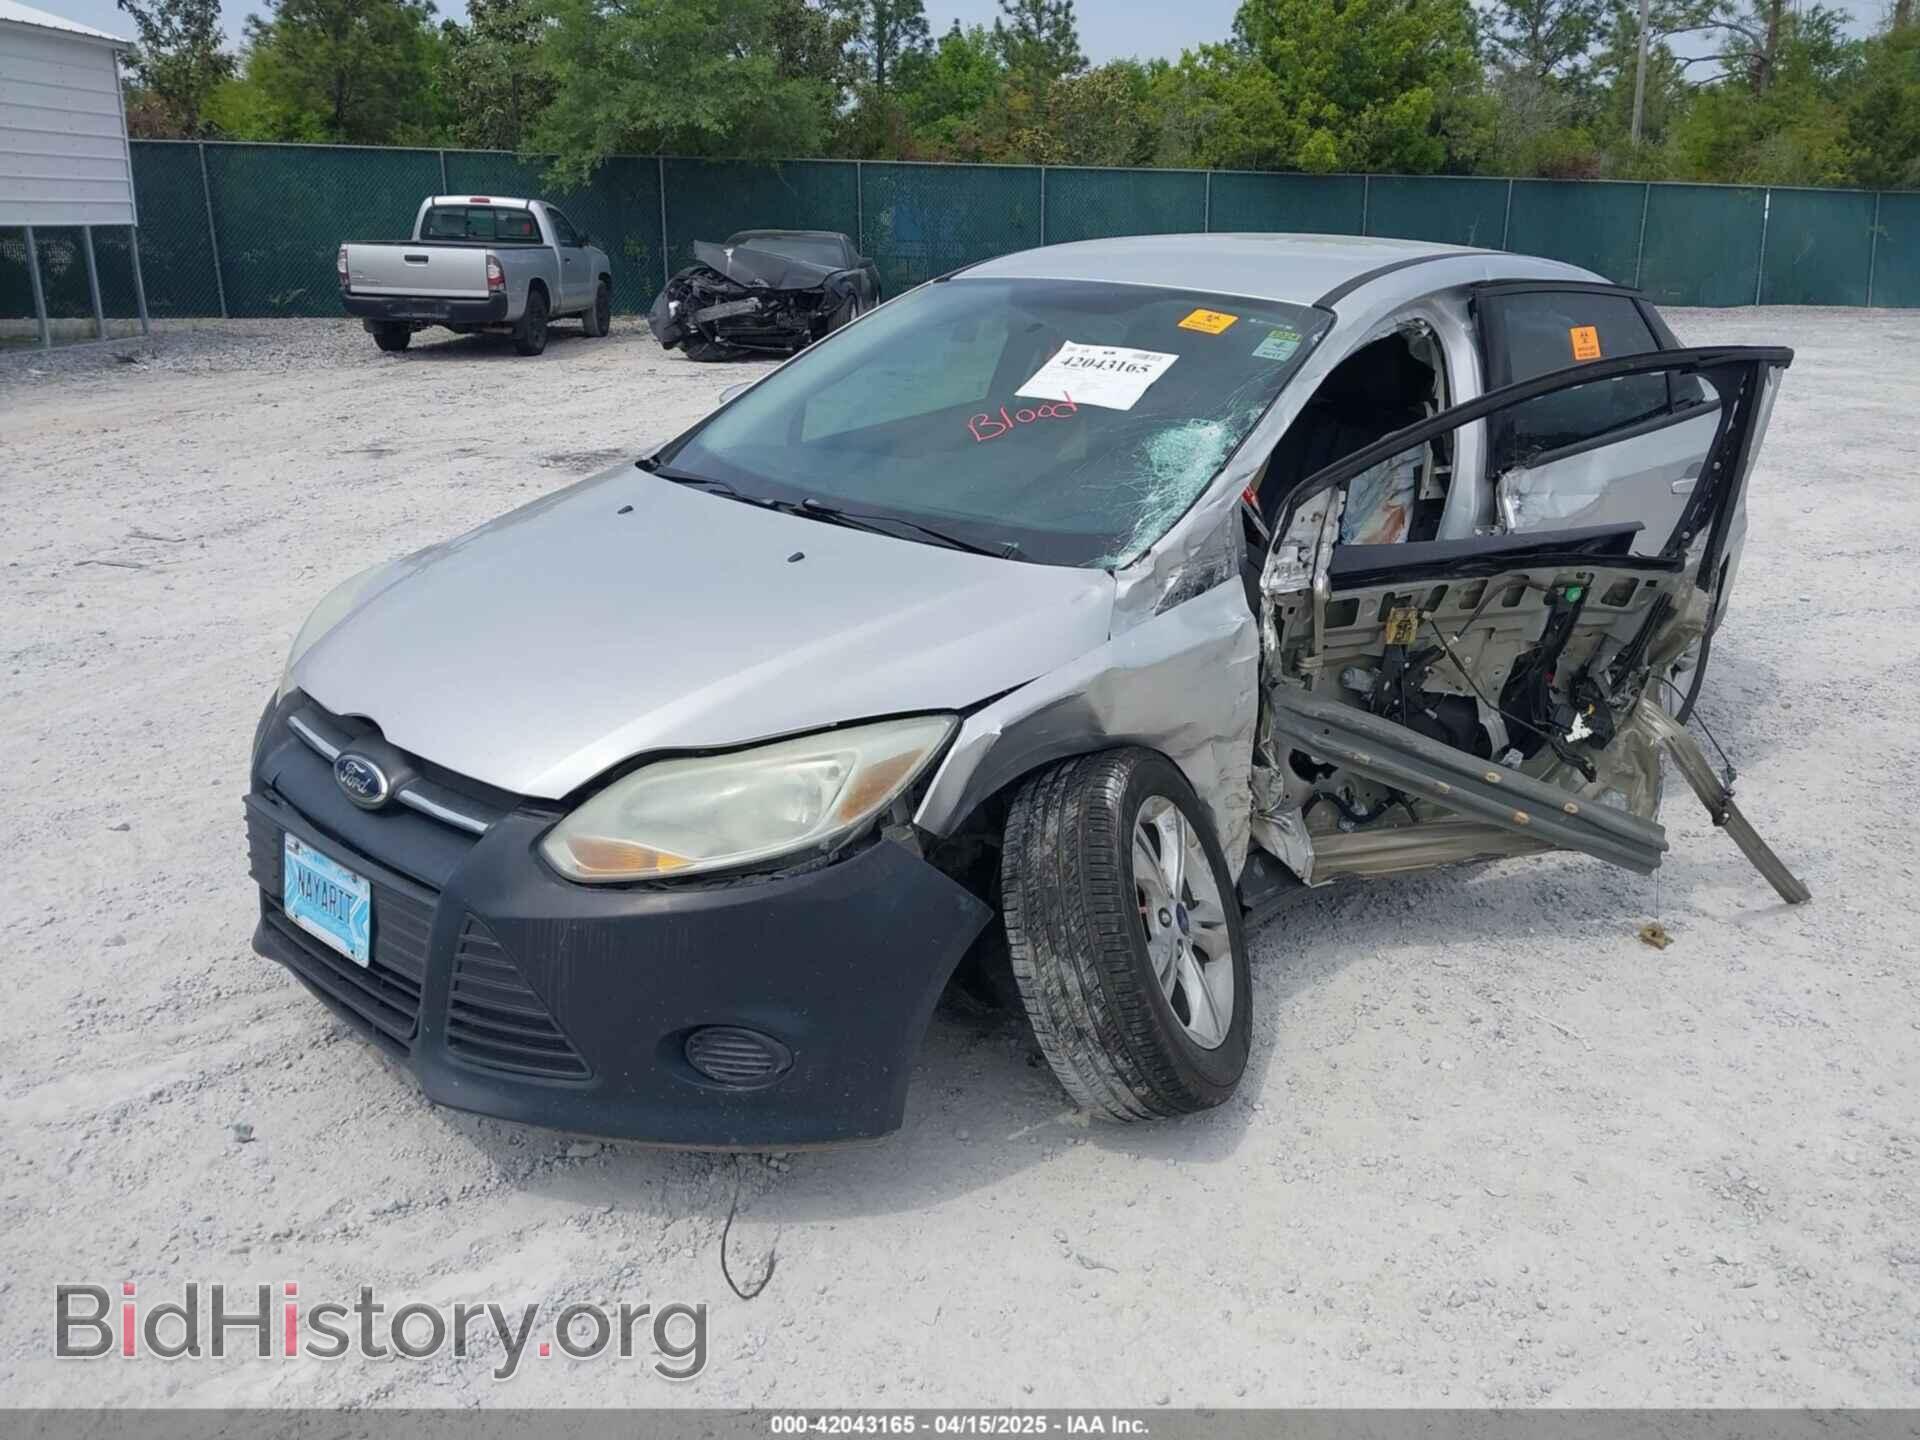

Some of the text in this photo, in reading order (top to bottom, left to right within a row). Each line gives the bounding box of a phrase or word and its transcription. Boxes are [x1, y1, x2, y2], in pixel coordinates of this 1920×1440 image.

[1060, 355, 1153, 374] 42043165
[967, 390, 1079, 443] Blood
[340, 761, 371, 794] Ford
[297, 865, 352, 925] NAYARIT
